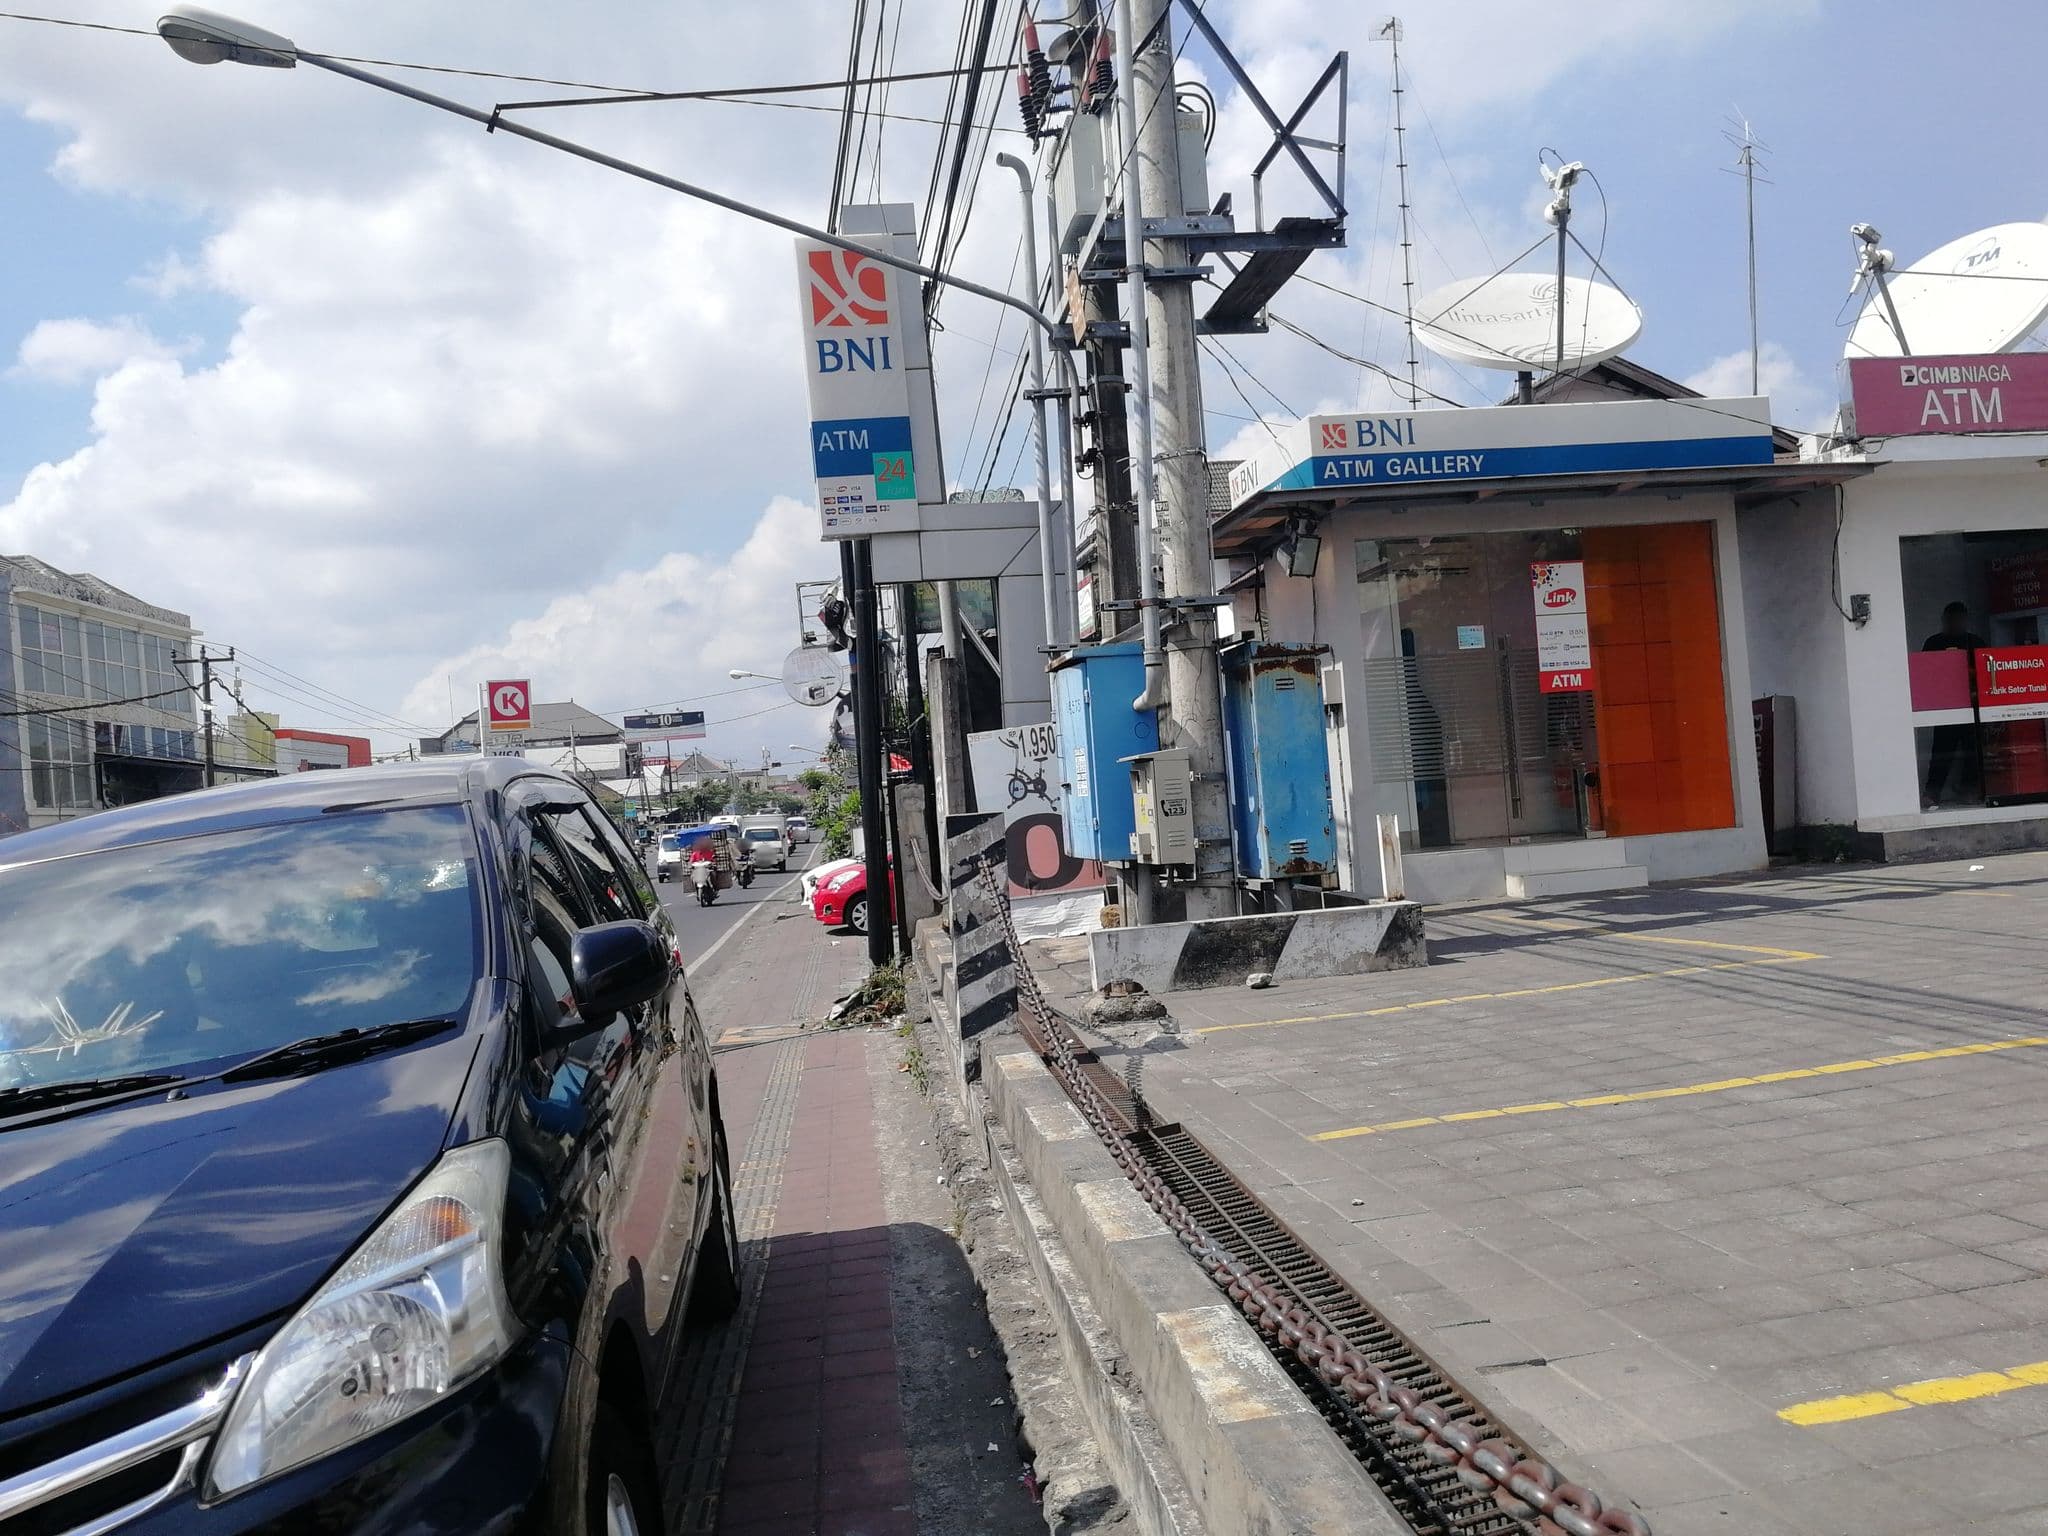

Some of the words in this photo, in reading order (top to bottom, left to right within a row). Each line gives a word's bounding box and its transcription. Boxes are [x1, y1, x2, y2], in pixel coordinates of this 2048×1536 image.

[816, 336, 892, 373] BNI
[1921, 387, 2004, 426] ATM
[819, 429, 869, 452] ATM
[1356, 417, 1416, 448] BNI
[877, 457, 907, 482] 24
[1240, 460, 1258, 496] BNI
[1323, 459, 1374, 479] ATM
[1386, 454, 1485, 475] GALLERY
[1544, 590, 1575, 605] Link
[1551, 674, 1582, 688] ATM
[658, 714, 672, 726] 10
[1019, 725, 1056, 758] 1.950
[1168, 807, 1184, 815] 123
